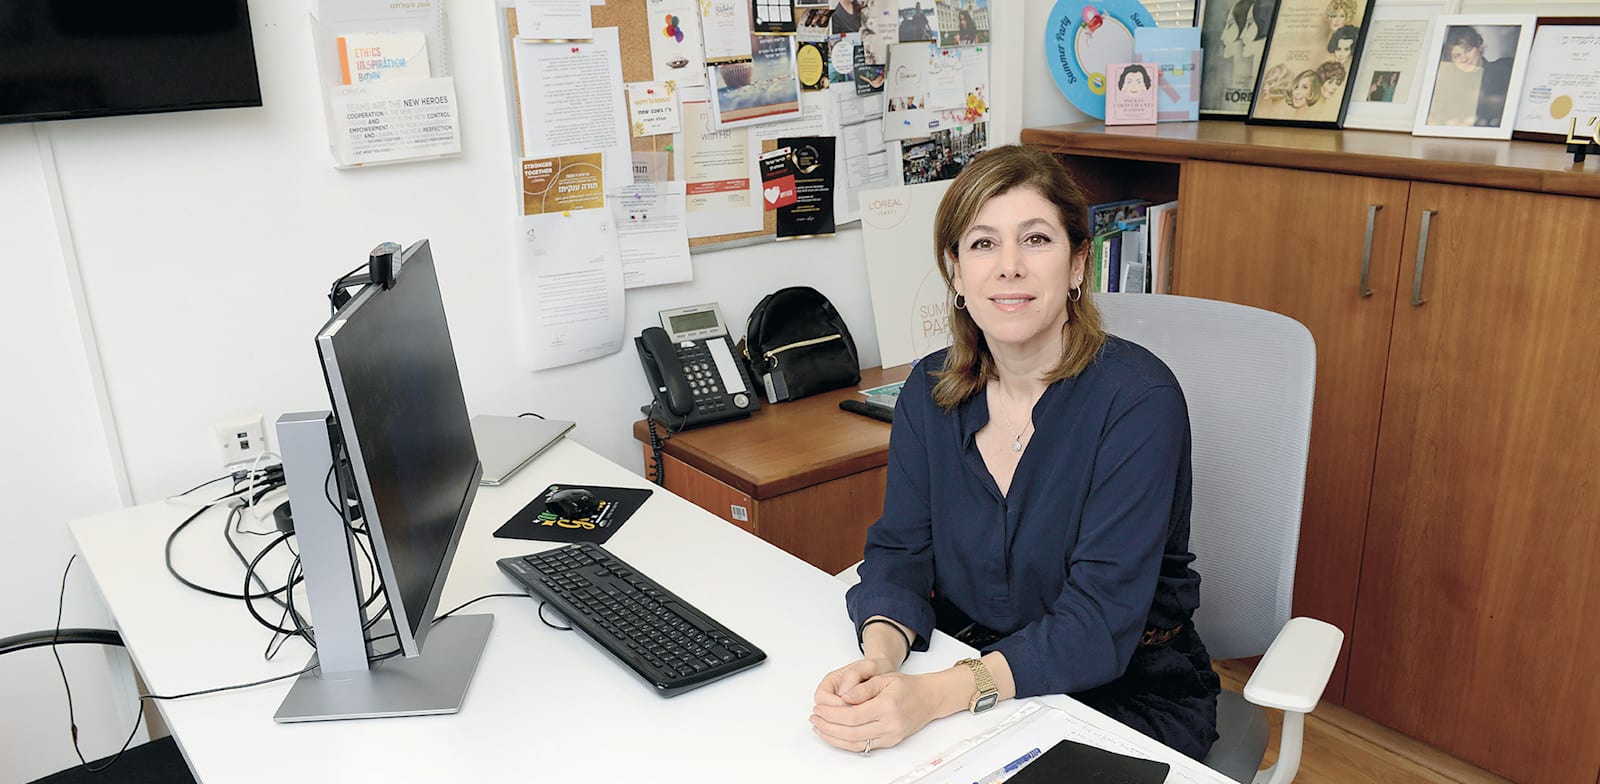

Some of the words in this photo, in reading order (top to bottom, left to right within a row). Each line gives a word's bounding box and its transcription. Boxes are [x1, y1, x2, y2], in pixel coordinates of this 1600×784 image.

[1056, 15, 1071, 41] Party
[1058, 44, 1078, 84] Summer
[403, 98, 420, 108] NEW
[421, 95, 449, 106] HEROES
[346, 111, 385, 120] COOPERATION
[427, 112, 451, 120] CONTROL
[349, 124, 389, 134] EMPOWERMENT
[422, 125, 453, 133] PERFECTION
[524, 161, 553, 170] STRONGER
[524, 168, 553, 176] TOGETHER
[922, 316, 951, 338] PAR
